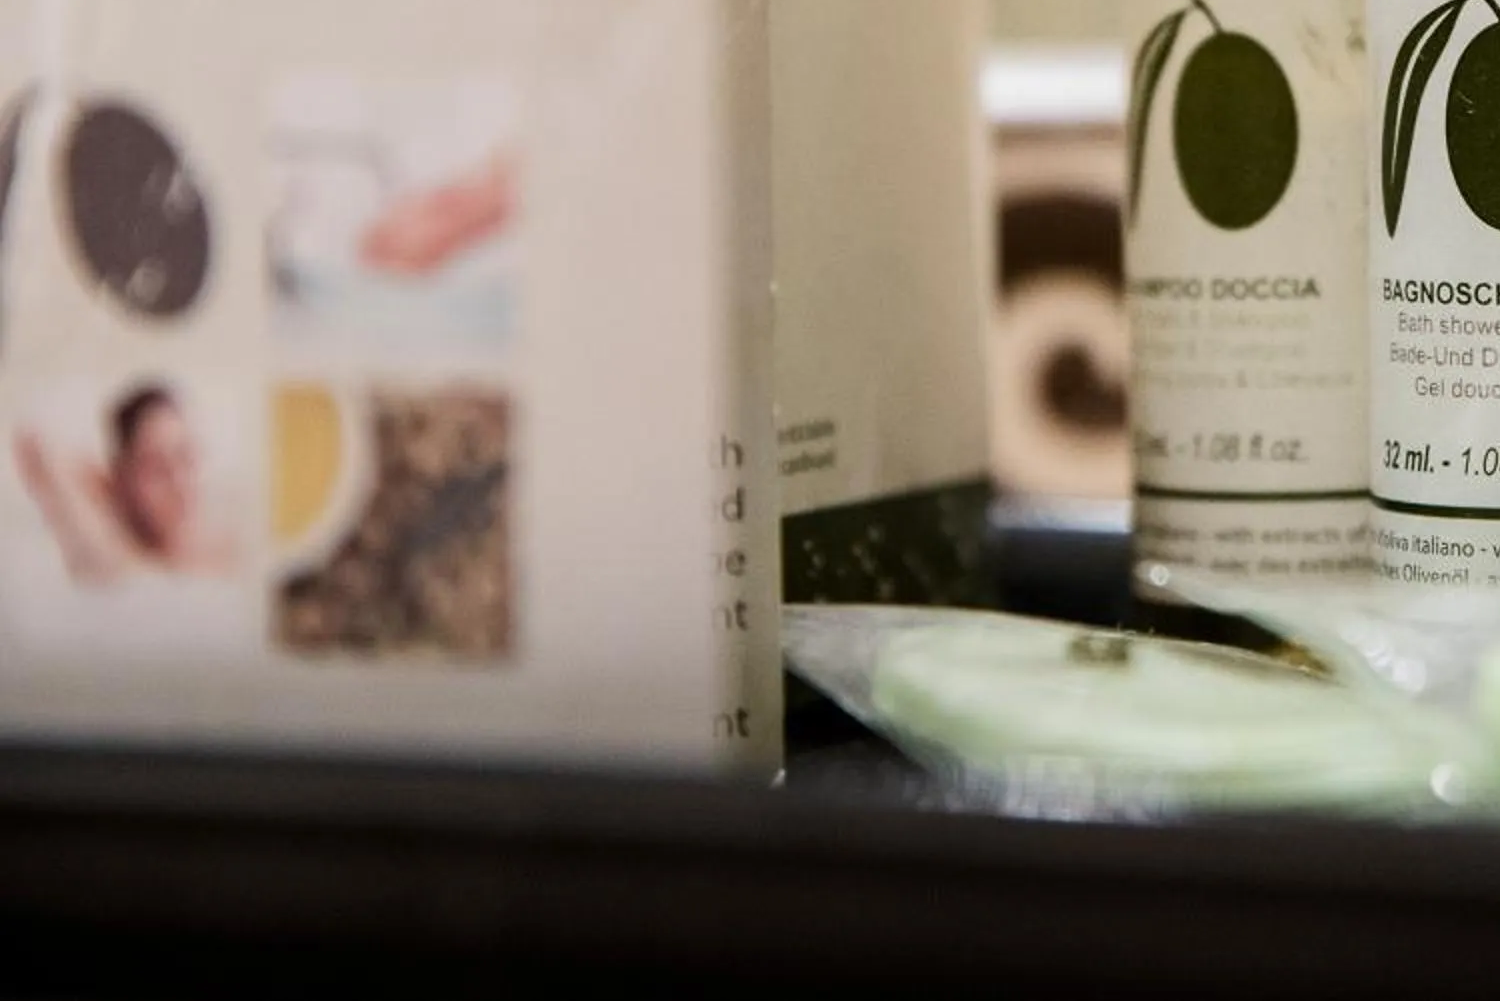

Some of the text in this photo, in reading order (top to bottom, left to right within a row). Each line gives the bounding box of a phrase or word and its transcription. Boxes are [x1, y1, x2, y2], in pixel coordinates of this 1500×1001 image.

[1210, 276, 1322, 301] DOCCIA
[1398, 312, 1434, 334] Bath
[1389, 341, 1474, 369] Bade-Und
[1414, 376, 1445, 397] Gel
[1383, 439, 1401, 469] 32
[1404, 443, 1435, 473] ml.
[1411, 534, 1475, 558] italiano
